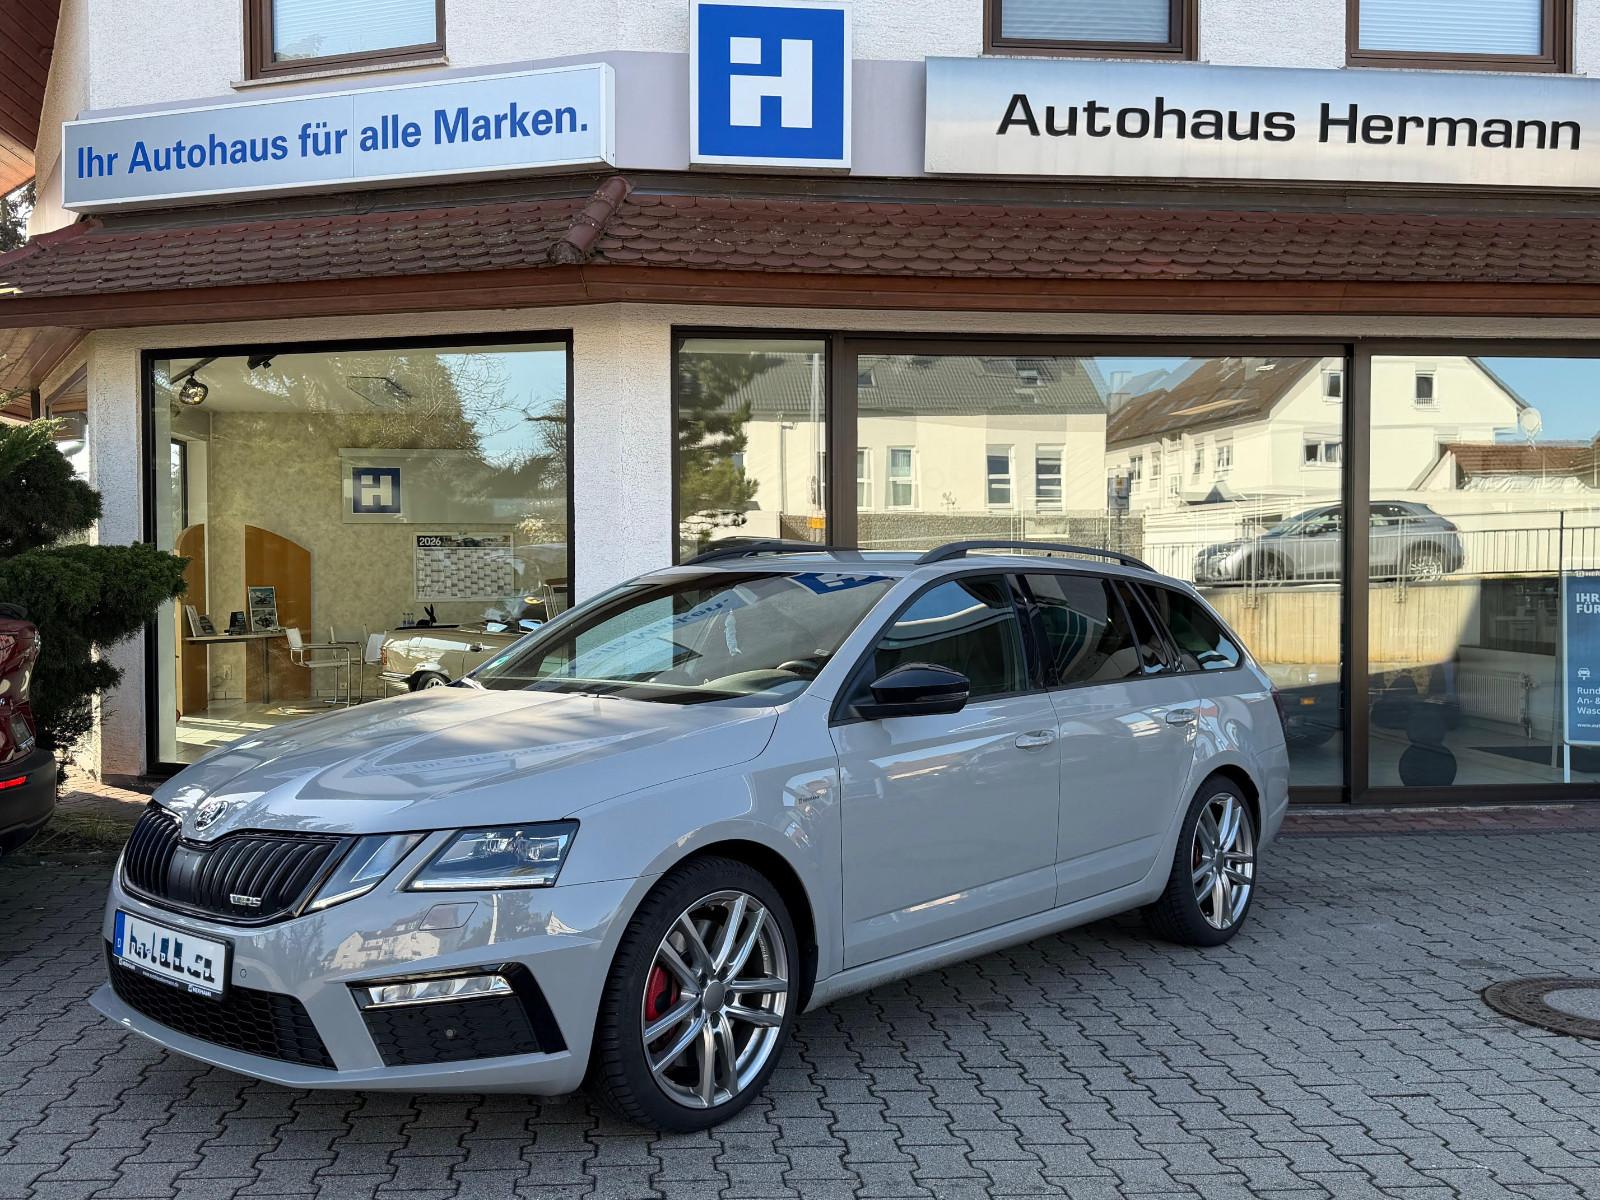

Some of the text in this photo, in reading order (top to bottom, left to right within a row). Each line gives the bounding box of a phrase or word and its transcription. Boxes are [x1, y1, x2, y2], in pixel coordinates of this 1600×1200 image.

[995, 93, 1581, 151] Autohaus Hermann
[77, 101, 588, 179] Ihr Autohaus für alle Marken.
[419, 537, 442, 546] 2026
[1576, 602, 1600, 614] FÜR
[1577, 686, 1600, 695] Rund
[1577, 696, 1593, 705] An-
